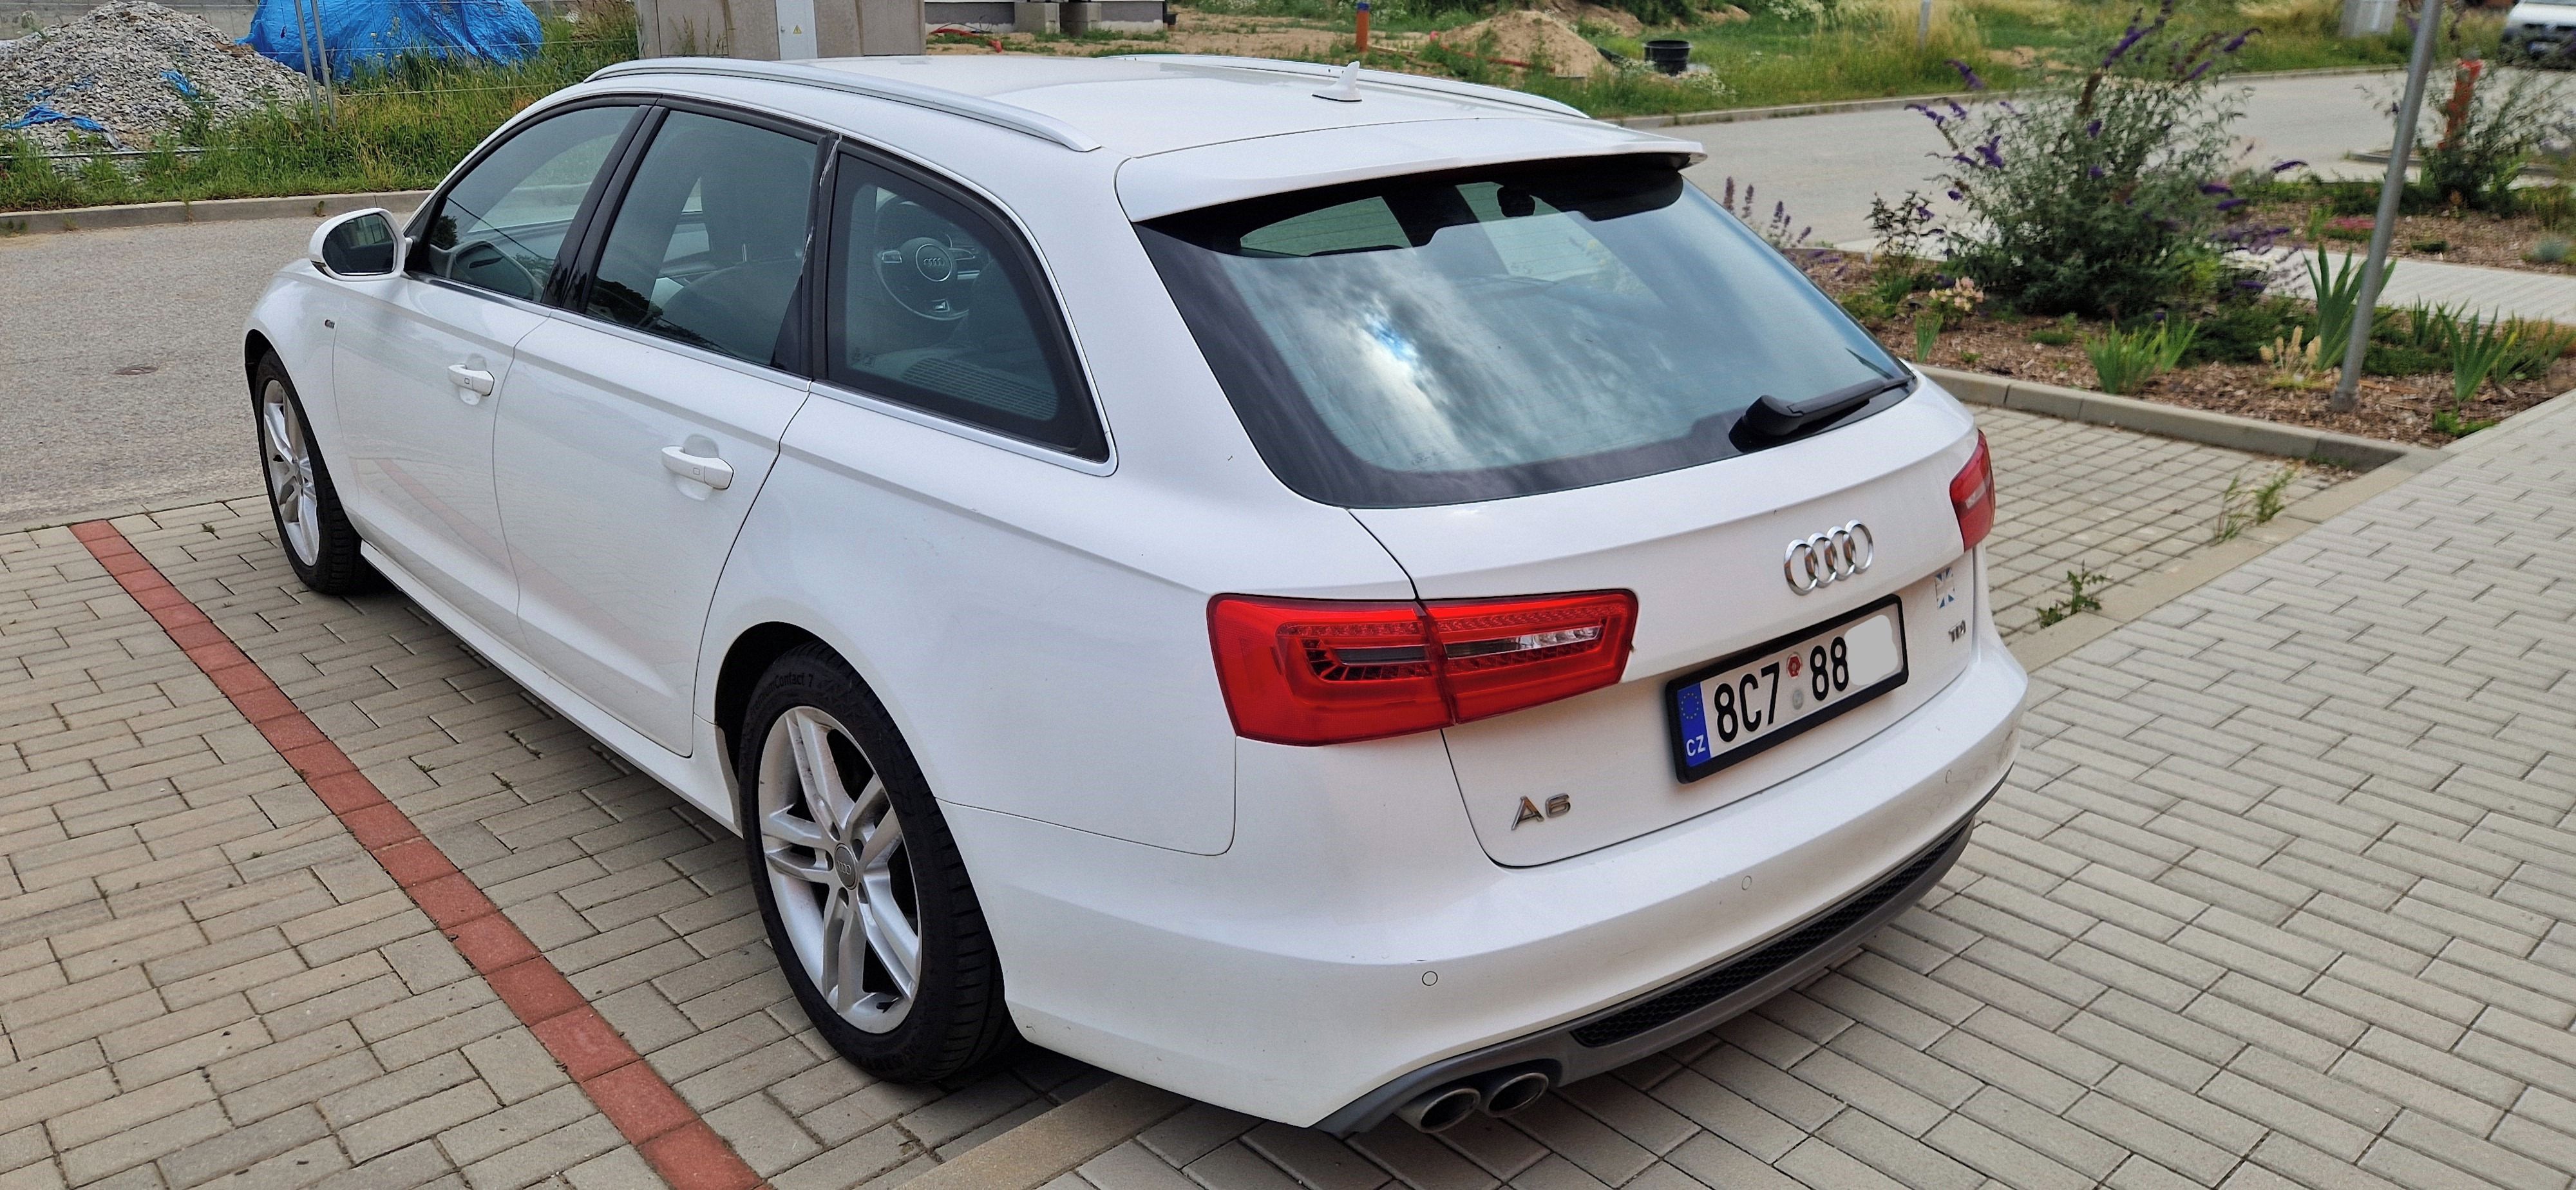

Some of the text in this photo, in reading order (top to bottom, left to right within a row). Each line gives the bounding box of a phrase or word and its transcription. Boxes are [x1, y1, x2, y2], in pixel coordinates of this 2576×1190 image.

[751, 672, 814, 716] remiumContact 7
[1714, 661, 1780, 742] 8C7
[1685, 734, 1706, 757] CZ
[1511, 793, 1571, 831] A6
